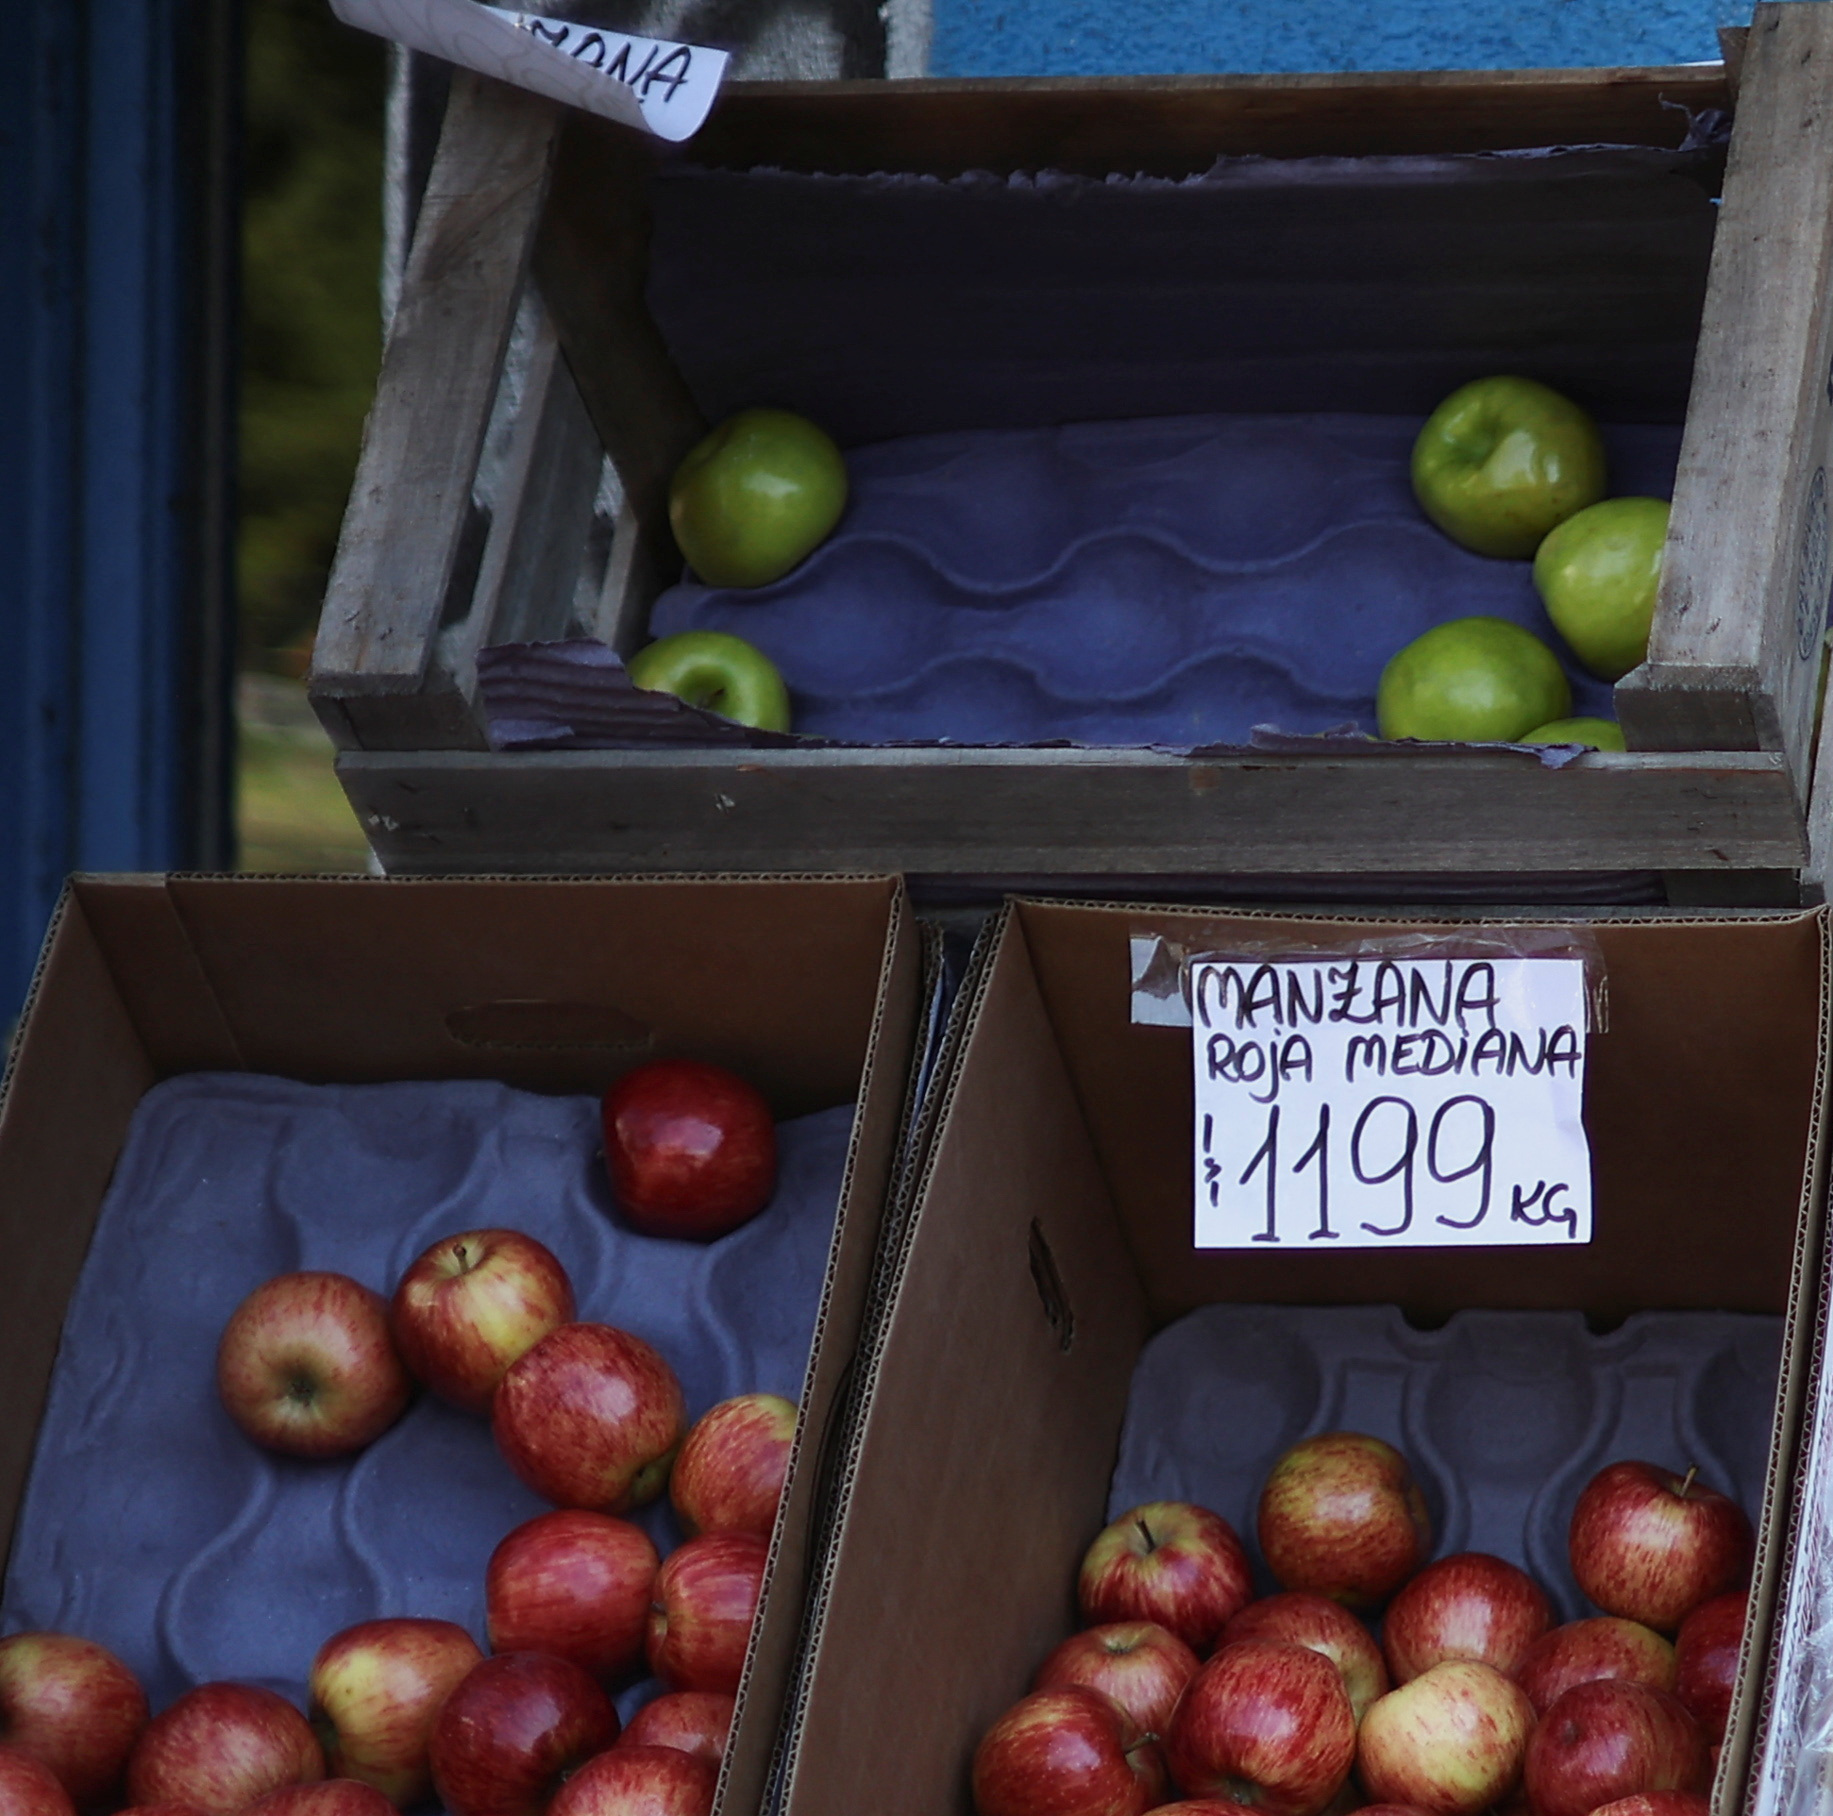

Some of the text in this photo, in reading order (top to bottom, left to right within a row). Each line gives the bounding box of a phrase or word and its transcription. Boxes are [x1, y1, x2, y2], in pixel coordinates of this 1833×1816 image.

[1198, 960, 1500, 1029] MANZANA
[1206, 1024, 1582, 1103] ROJA MEDIANA
[1510, 1180, 1578, 1239] KG
